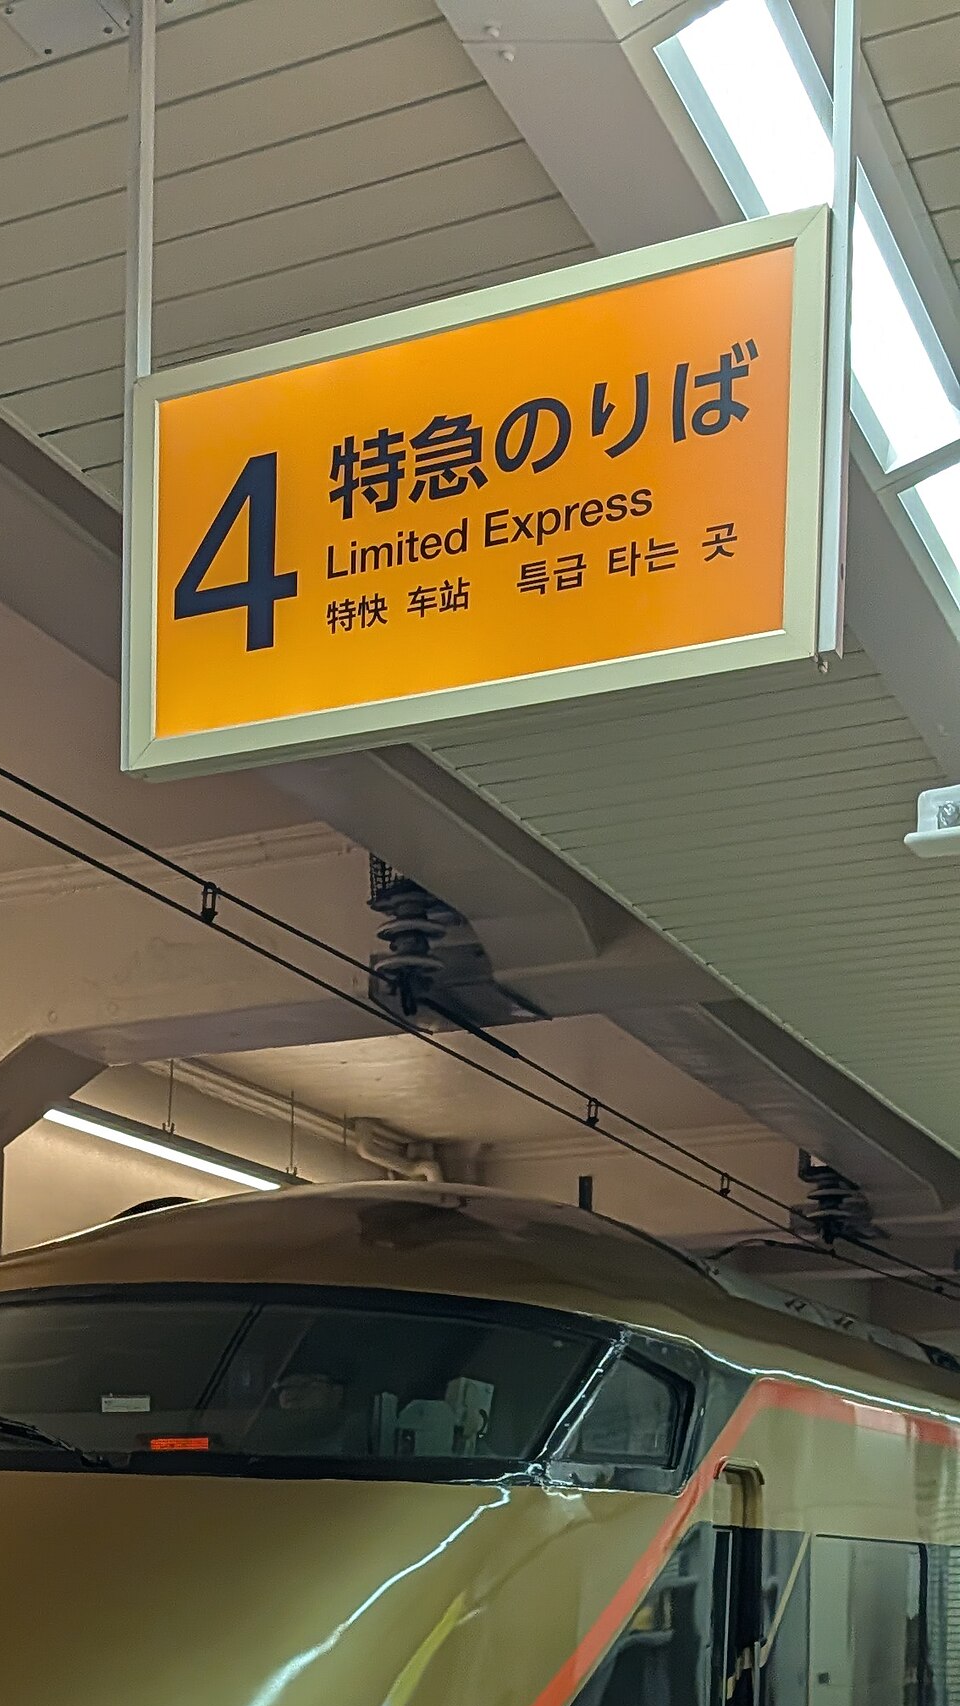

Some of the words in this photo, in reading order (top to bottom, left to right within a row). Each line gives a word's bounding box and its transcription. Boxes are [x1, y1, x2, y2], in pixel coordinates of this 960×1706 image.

[328, 338, 759, 521] 特急のりば
[173, 451, 298, 653] 4
[327, 517, 468, 580] Limited
[483, 488, 654, 549] Express
[516, 553, 587, 596] 특급
[608, 537, 679, 577] 타는
[701, 522, 738, 562] 곳
[326, 592, 388, 635] 特快
[406, 576, 471, 619] 车站
